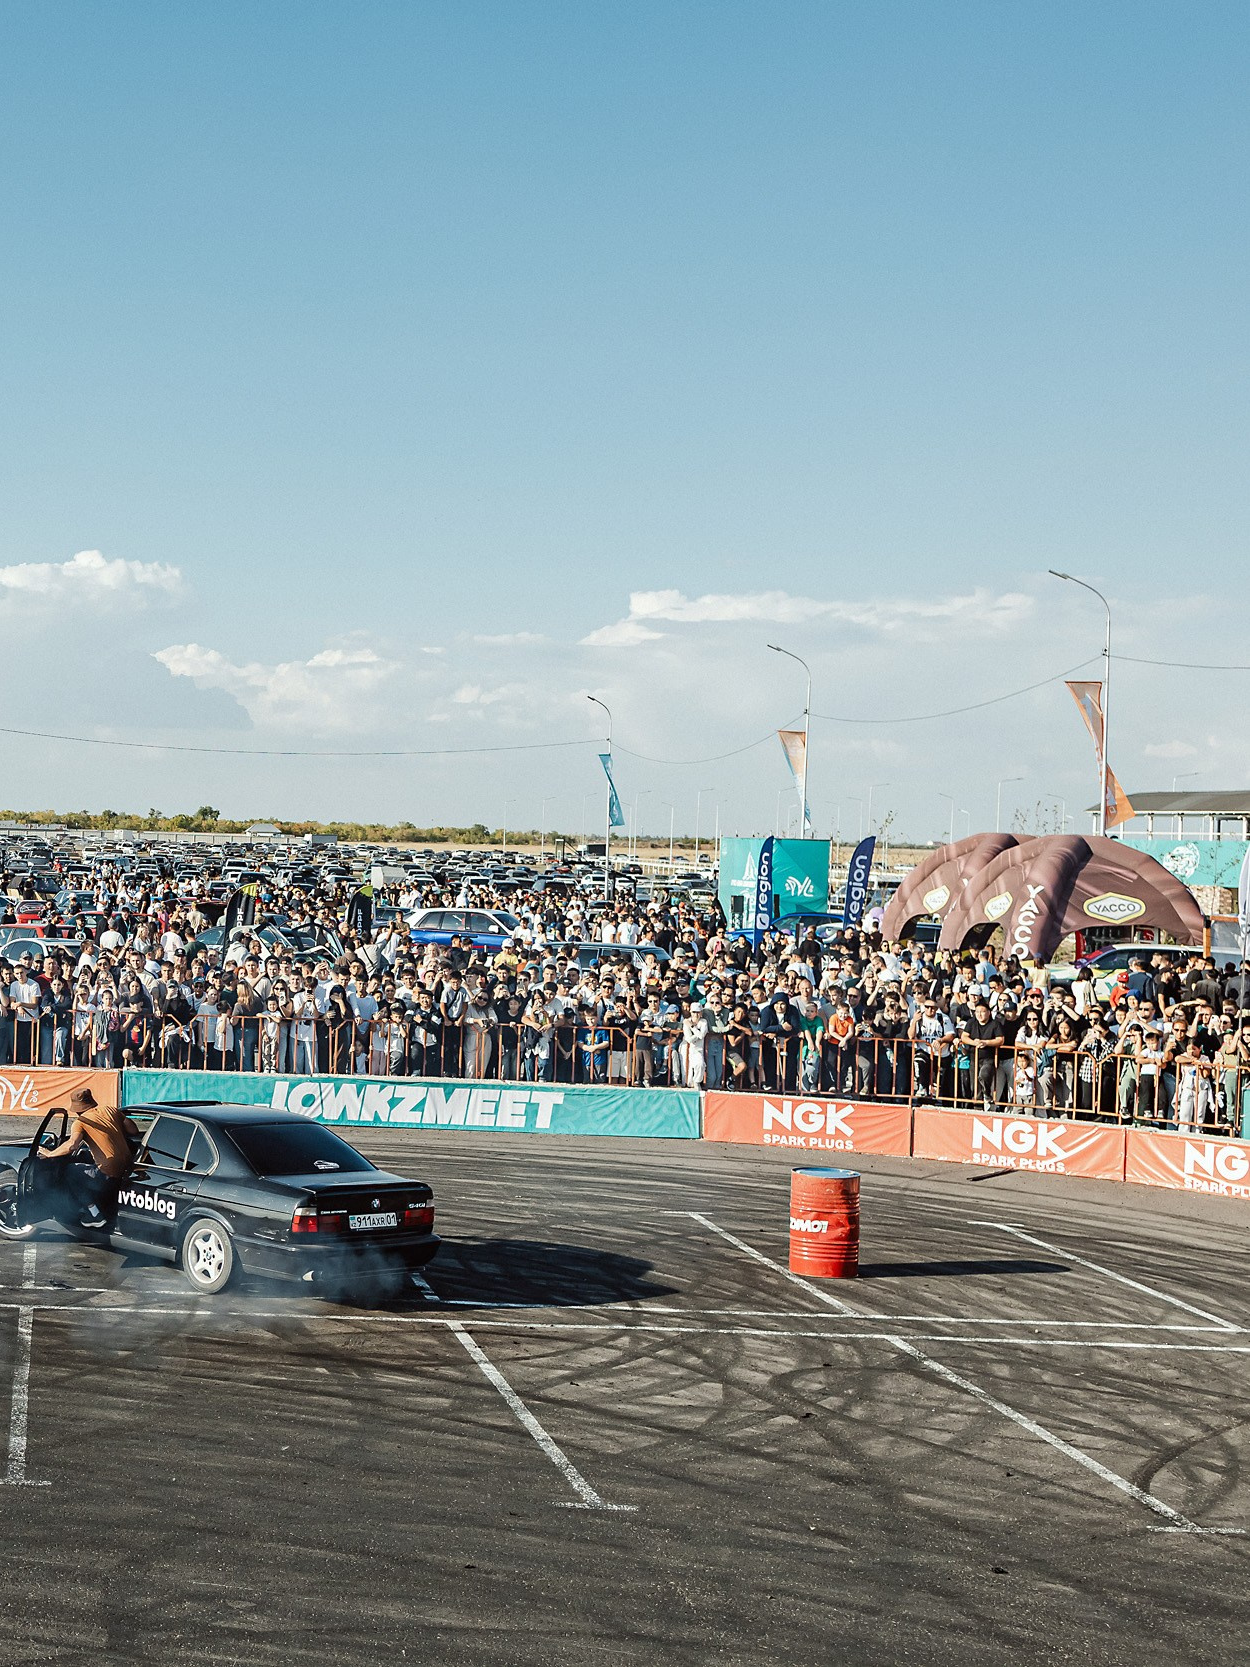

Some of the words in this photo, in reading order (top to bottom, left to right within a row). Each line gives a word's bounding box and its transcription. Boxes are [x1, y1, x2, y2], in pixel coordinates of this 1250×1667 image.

[758, 852, 771, 912] region
[848, 855, 868, 922] region
[1011, 884, 1045, 960] YACCO
[1093, 903, 1136, 913] YACCO
[762, 1099, 855, 1138] NGK
[972, 1116, 1068, 1159] NGK
[763, 1133, 806, 1147] SPARK
[809, 1137, 854, 1150] PLUGS
[972, 1152, 1017, 1168] SPARK
